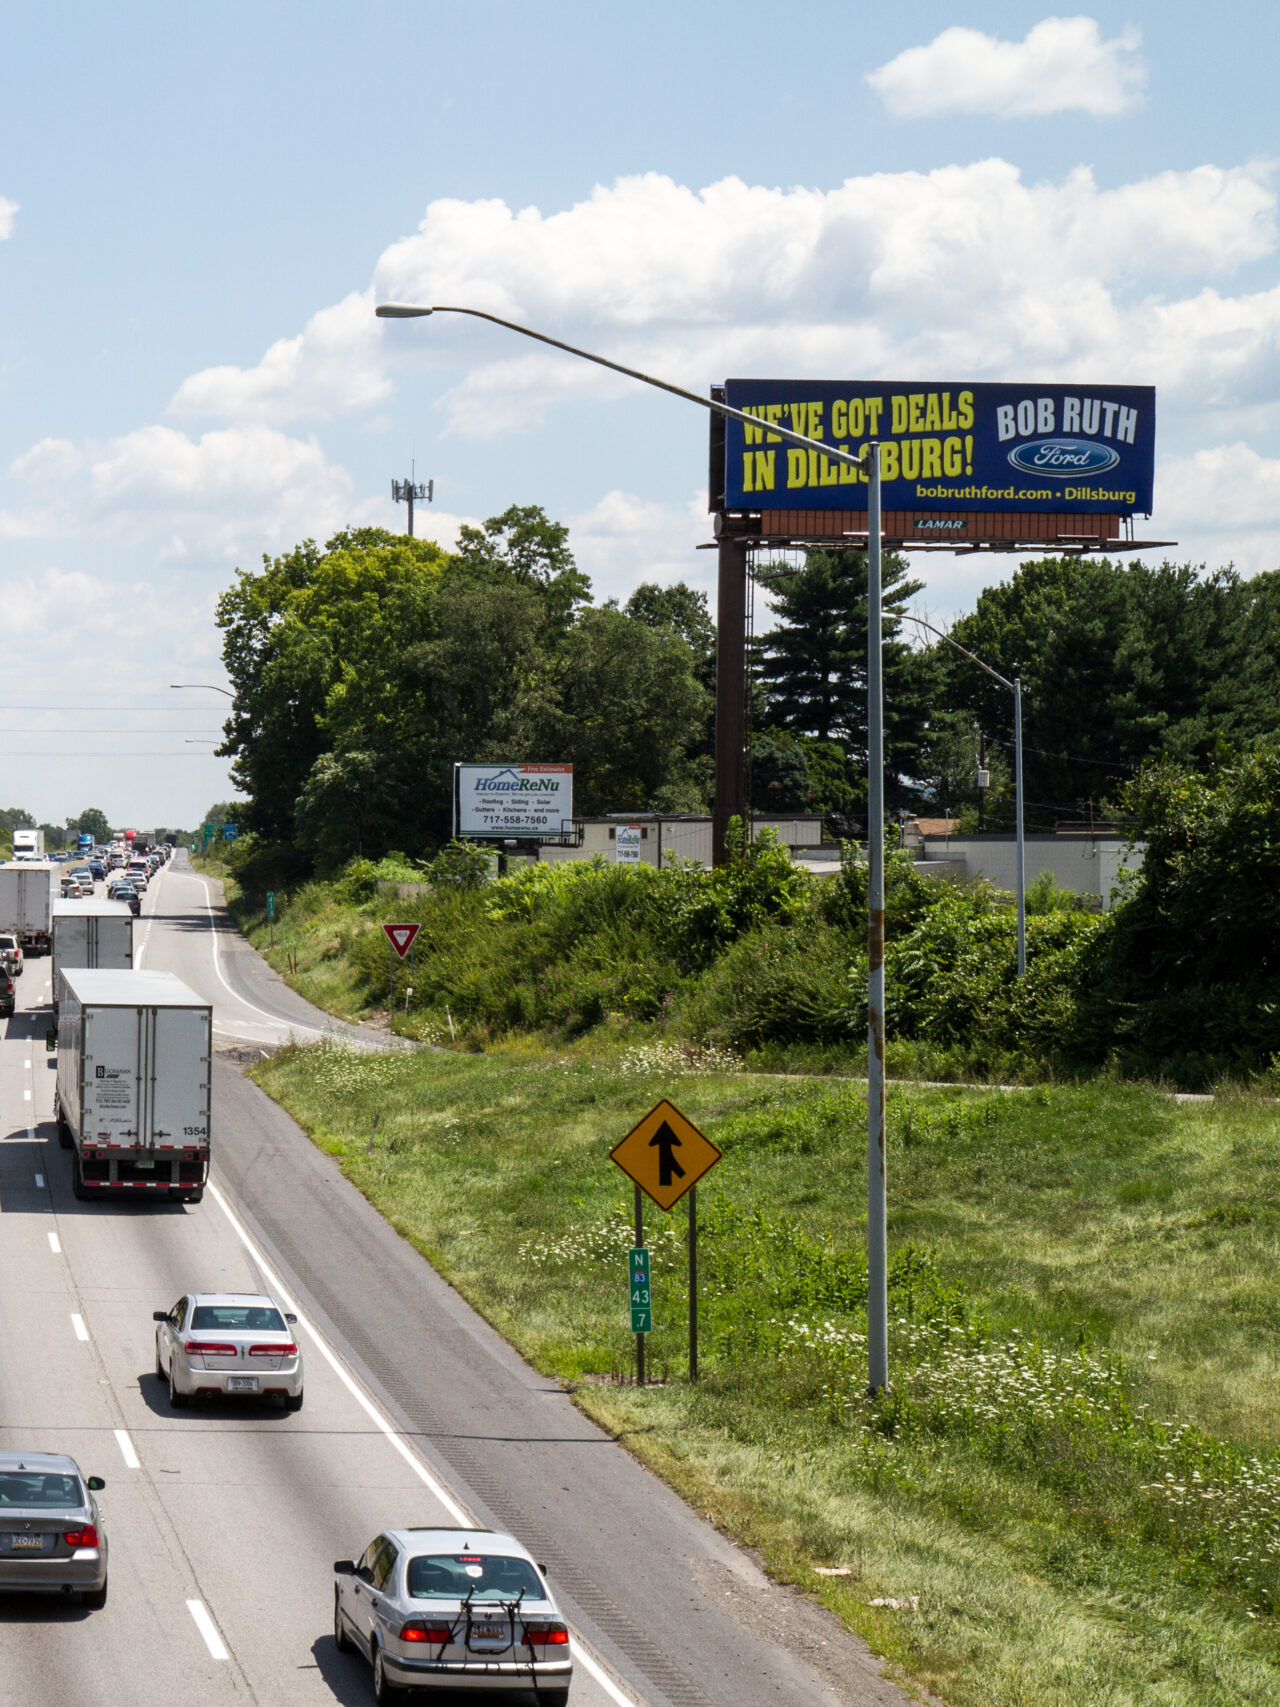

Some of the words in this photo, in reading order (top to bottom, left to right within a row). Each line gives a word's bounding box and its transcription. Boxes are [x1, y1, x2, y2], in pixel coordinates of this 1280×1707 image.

[742, 401, 824, 445] WE'VE
[831, 396, 883, 439] GOT
[891, 390, 975, 434] DEALS
[996, 397, 1056, 443] BOB
[1062, 396, 1138, 445] RUTH
[1033, 444, 1091, 466] Ford
[742, 450, 776, 493] IN
[916, 484, 1052, 500] bobruthford.com
[1064, 487, 1136, 504] Dillsburg
[917, 519, 963, 529] LAMAR
[474, 777, 560, 791] HomeReNu
[483, 815, 548, 824] 717-558-7560
[183, 1126, 207, 1136] 1354
[634, 1254, 644, 1266] N
[634, 1273, 646, 1282] 83
[632, 1289, 649, 1304] 43
